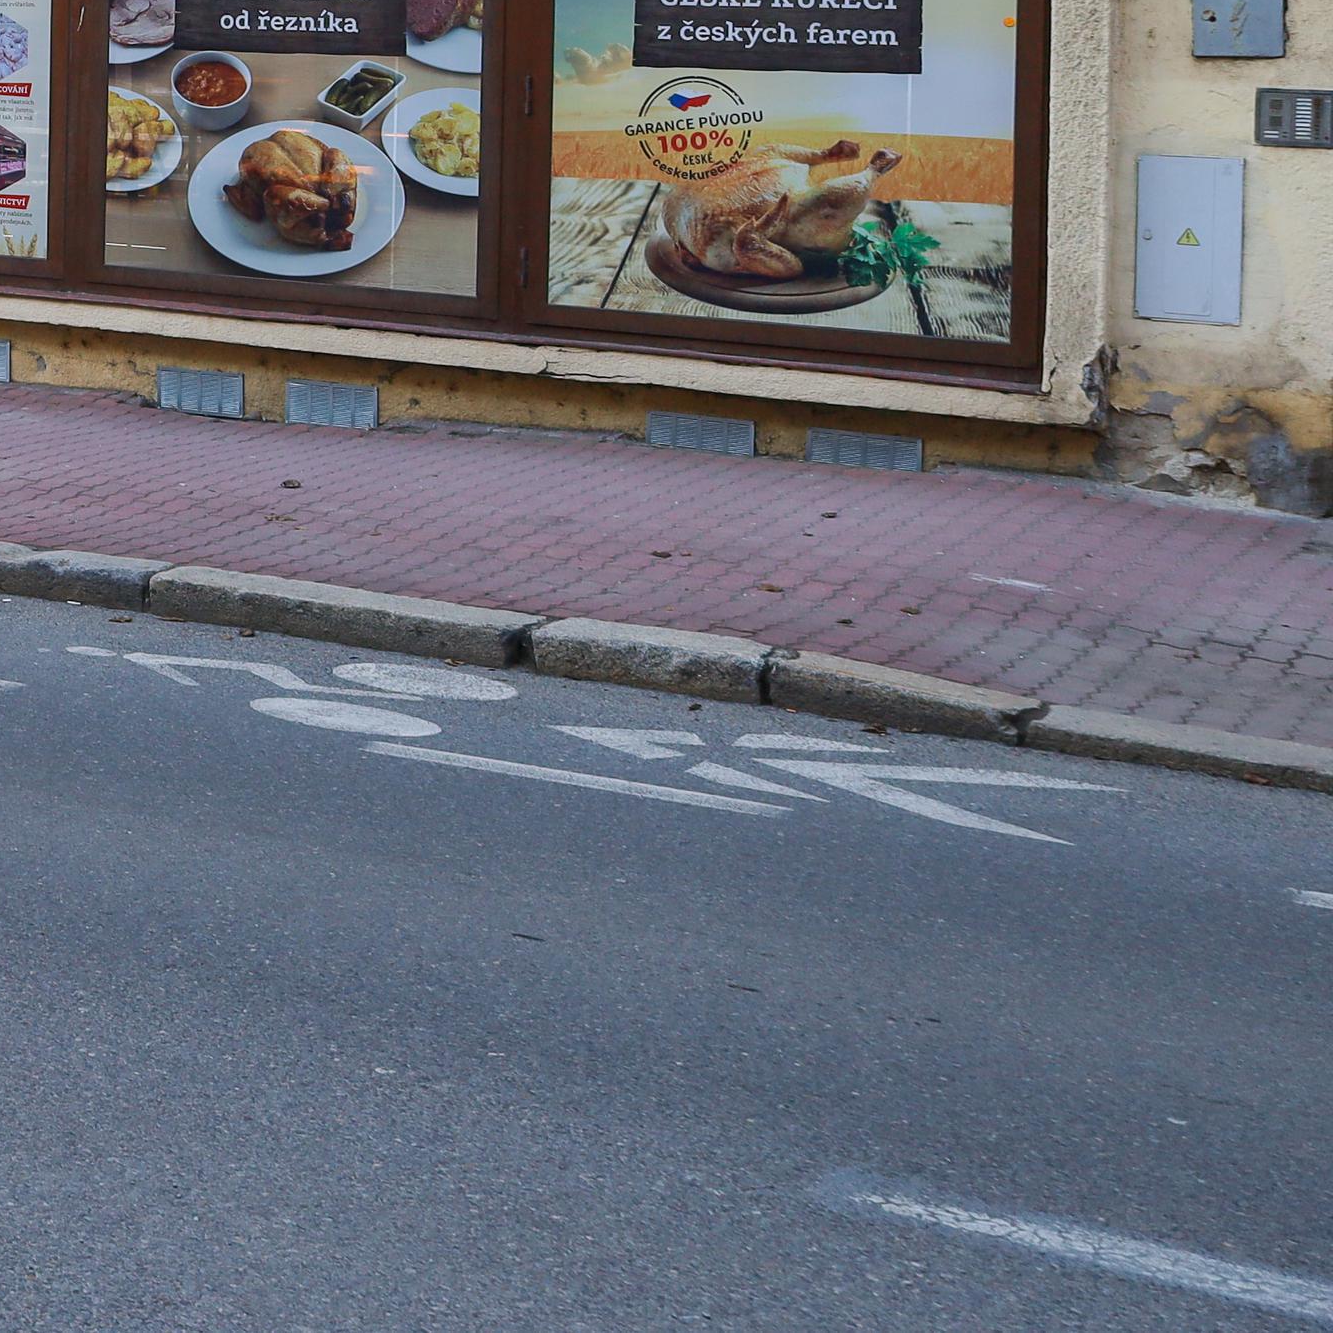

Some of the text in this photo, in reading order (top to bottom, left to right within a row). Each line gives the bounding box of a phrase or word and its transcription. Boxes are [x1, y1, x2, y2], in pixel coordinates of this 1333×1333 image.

[220, 9, 359, 33] od řezníka
[657, 20, 899, 48] z českých farem
[625, 110, 763, 136] GARANCE PŮVODU
[657, 129, 733, 153] 100%
[683, 152, 713, 165] ČESKÉ
